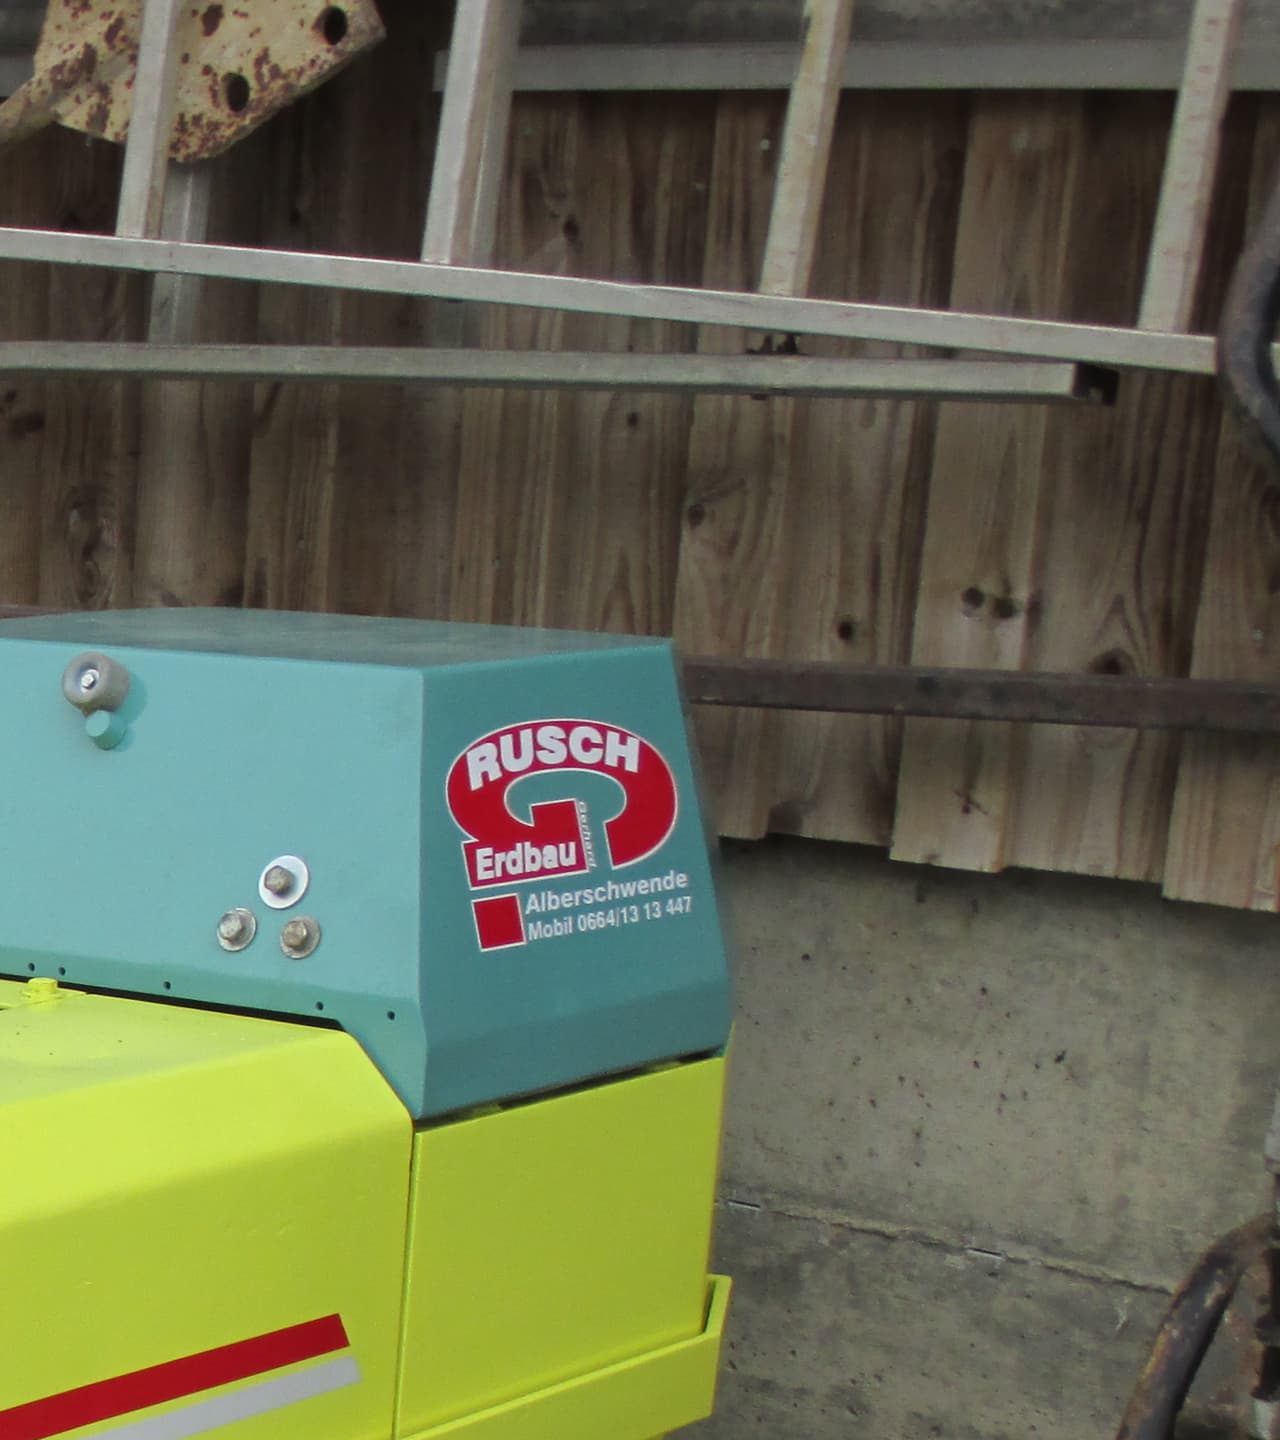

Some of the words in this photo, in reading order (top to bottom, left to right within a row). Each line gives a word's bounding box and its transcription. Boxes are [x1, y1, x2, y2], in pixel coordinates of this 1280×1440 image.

[466, 725, 640, 791] RUSCH
[475, 841, 577, 881] Erdbau
[525, 869, 688, 915] Alberschwende
[528, 915, 573, 941] Mobil
[577, 905, 640, 933] 0664/13
[643, 901, 662, 920] 13
[665, 896, 692, 915] 447
